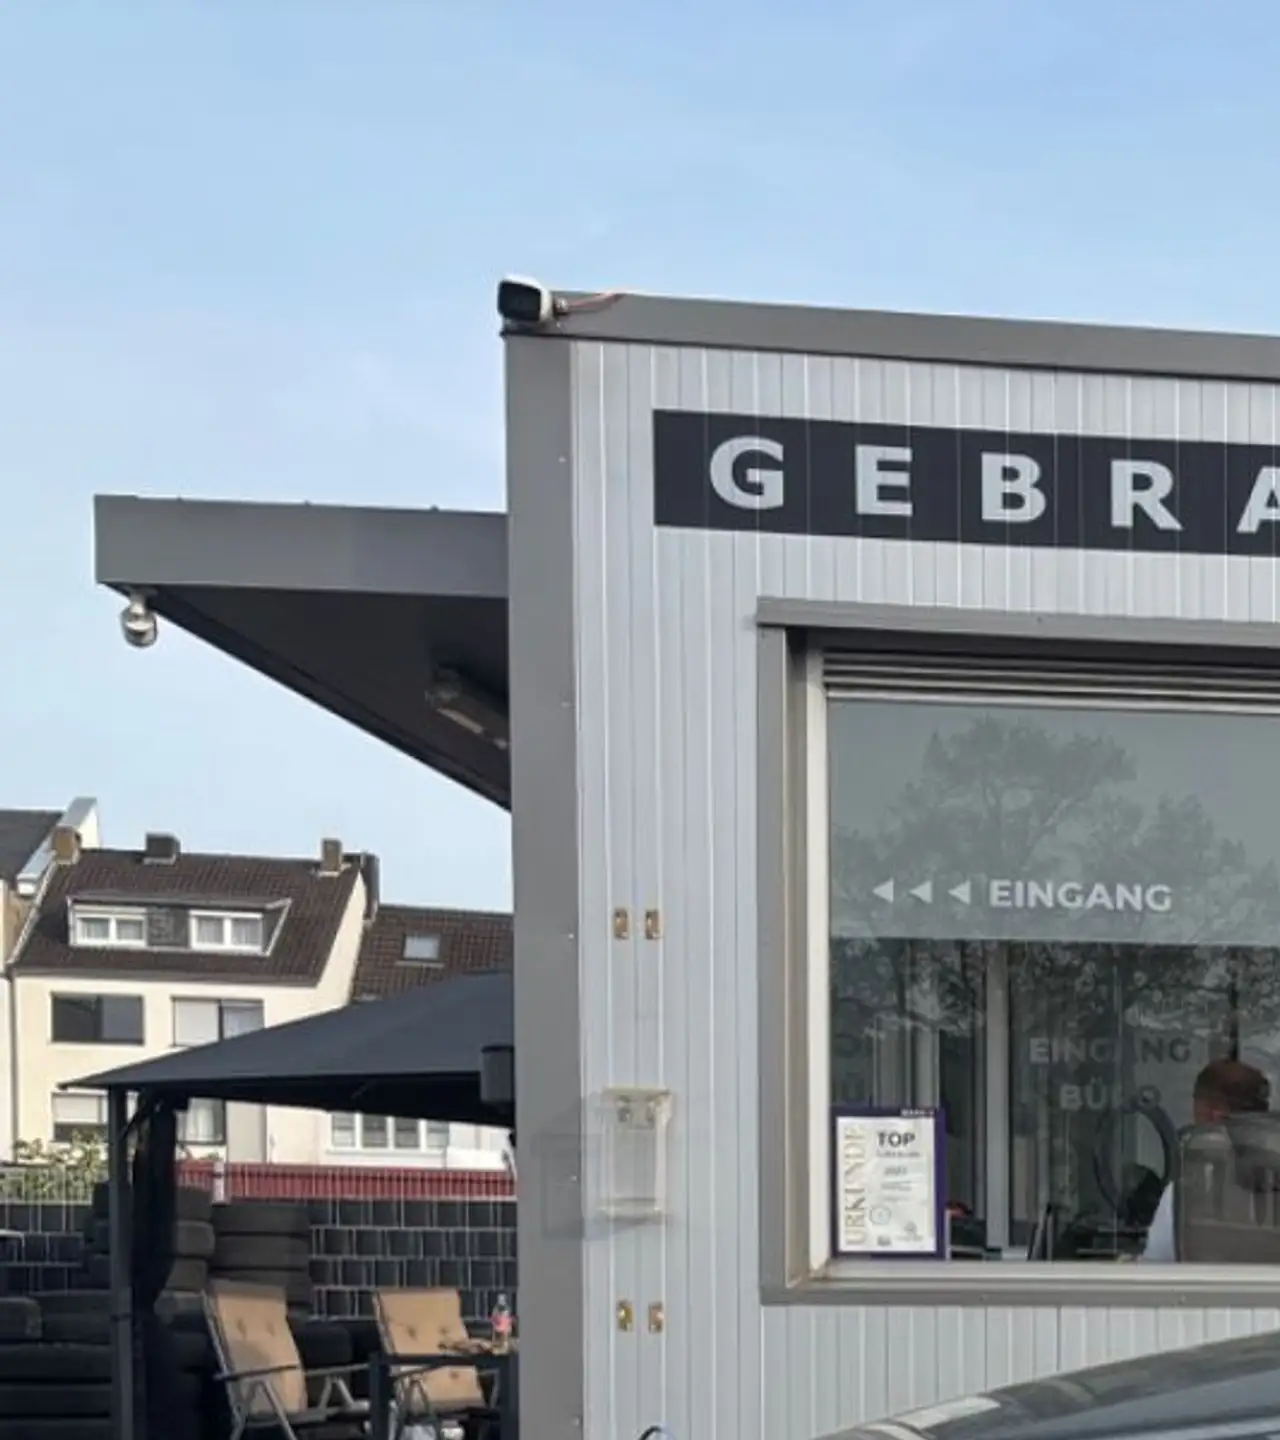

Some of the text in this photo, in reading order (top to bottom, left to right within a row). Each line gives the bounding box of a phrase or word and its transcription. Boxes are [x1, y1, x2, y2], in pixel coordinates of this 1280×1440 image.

[988, 879, 1172, 912] EINGANG
[1029, 1036, 1191, 1064] EINGNG
[878, 1132, 915, 1147] TOP
